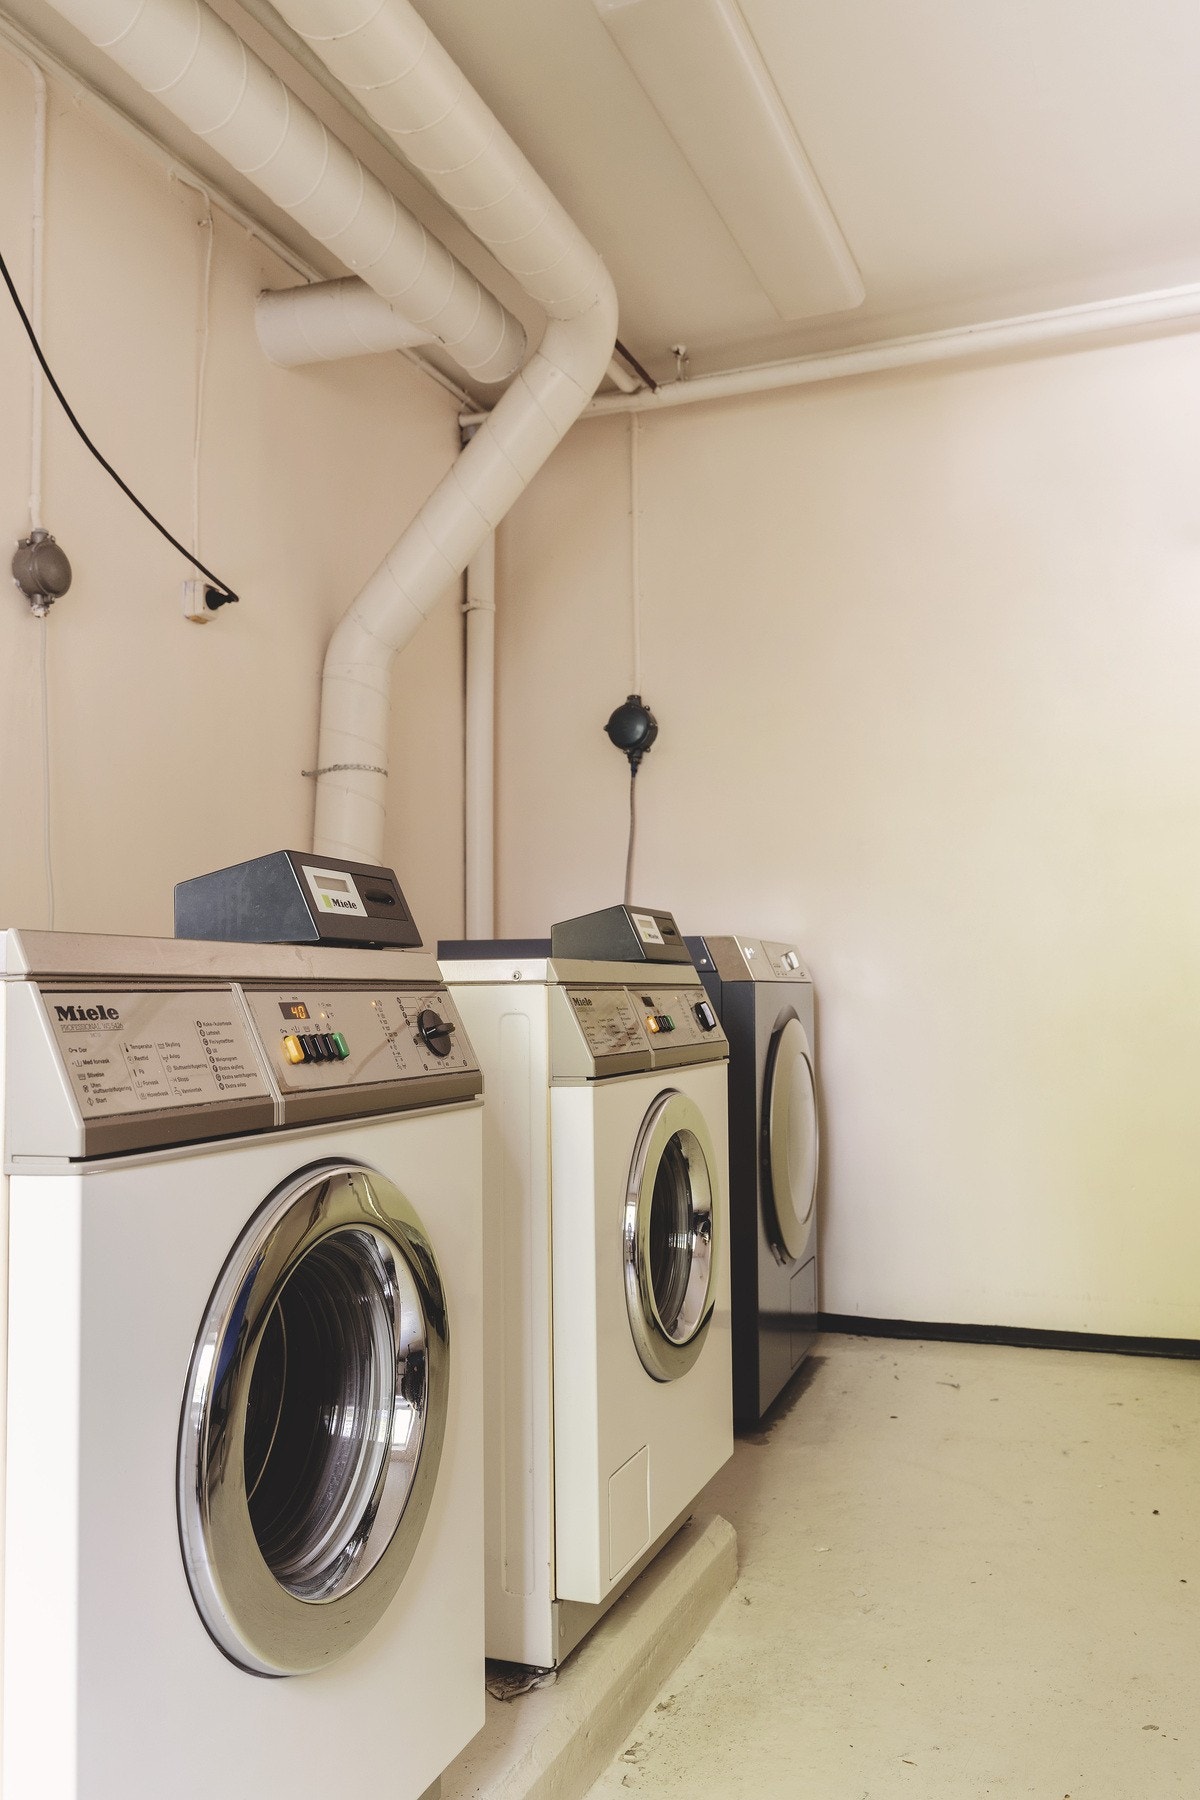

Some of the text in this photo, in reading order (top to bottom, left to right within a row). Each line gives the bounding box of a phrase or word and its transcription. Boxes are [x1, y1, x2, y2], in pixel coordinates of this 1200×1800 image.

[332, 898, 358, 909] Miele
[572, 997, 593, 1006] Miele
[54, 1005, 120, 1021] Miele
[291, 1005, 306, 1019] 40
